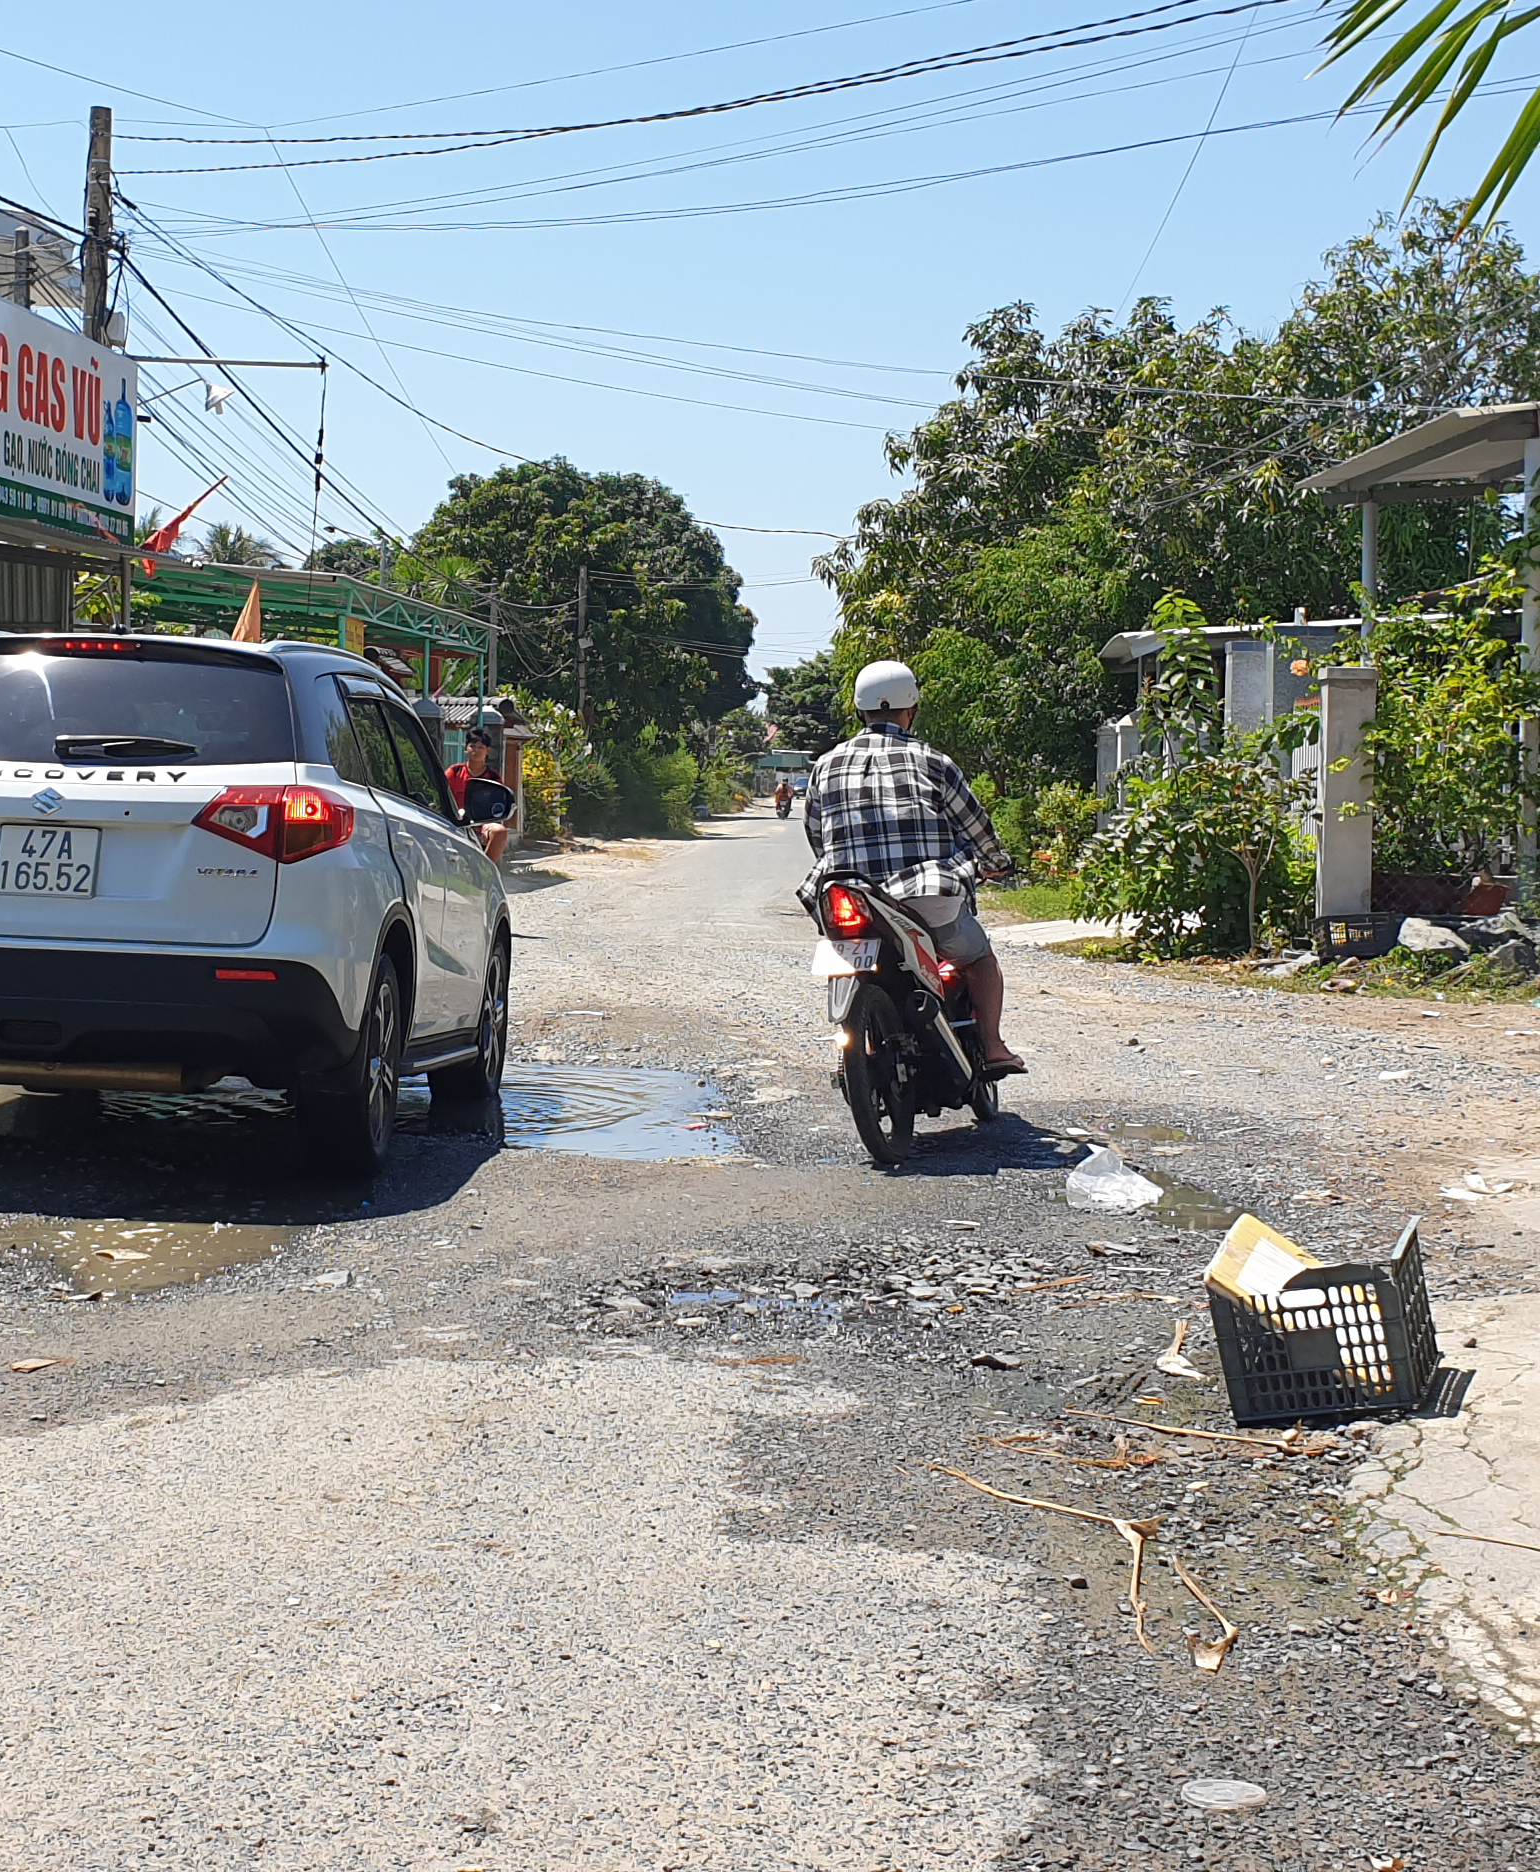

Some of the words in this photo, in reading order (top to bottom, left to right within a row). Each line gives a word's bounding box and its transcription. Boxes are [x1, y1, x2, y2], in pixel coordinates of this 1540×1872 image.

[17, 343, 66, 433] GAS
[72, 356, 102, 446] VŨ
[4, 430, 25, 477] GẠO,
[27, 435, 53, 479] NƯỚC
[81, 456, 100, 494] CHAI
[21, 829, 73, 860] 47A
[0, 860, 91, 893] 165.52
[829, 942, 870, 955] 9-Z1
